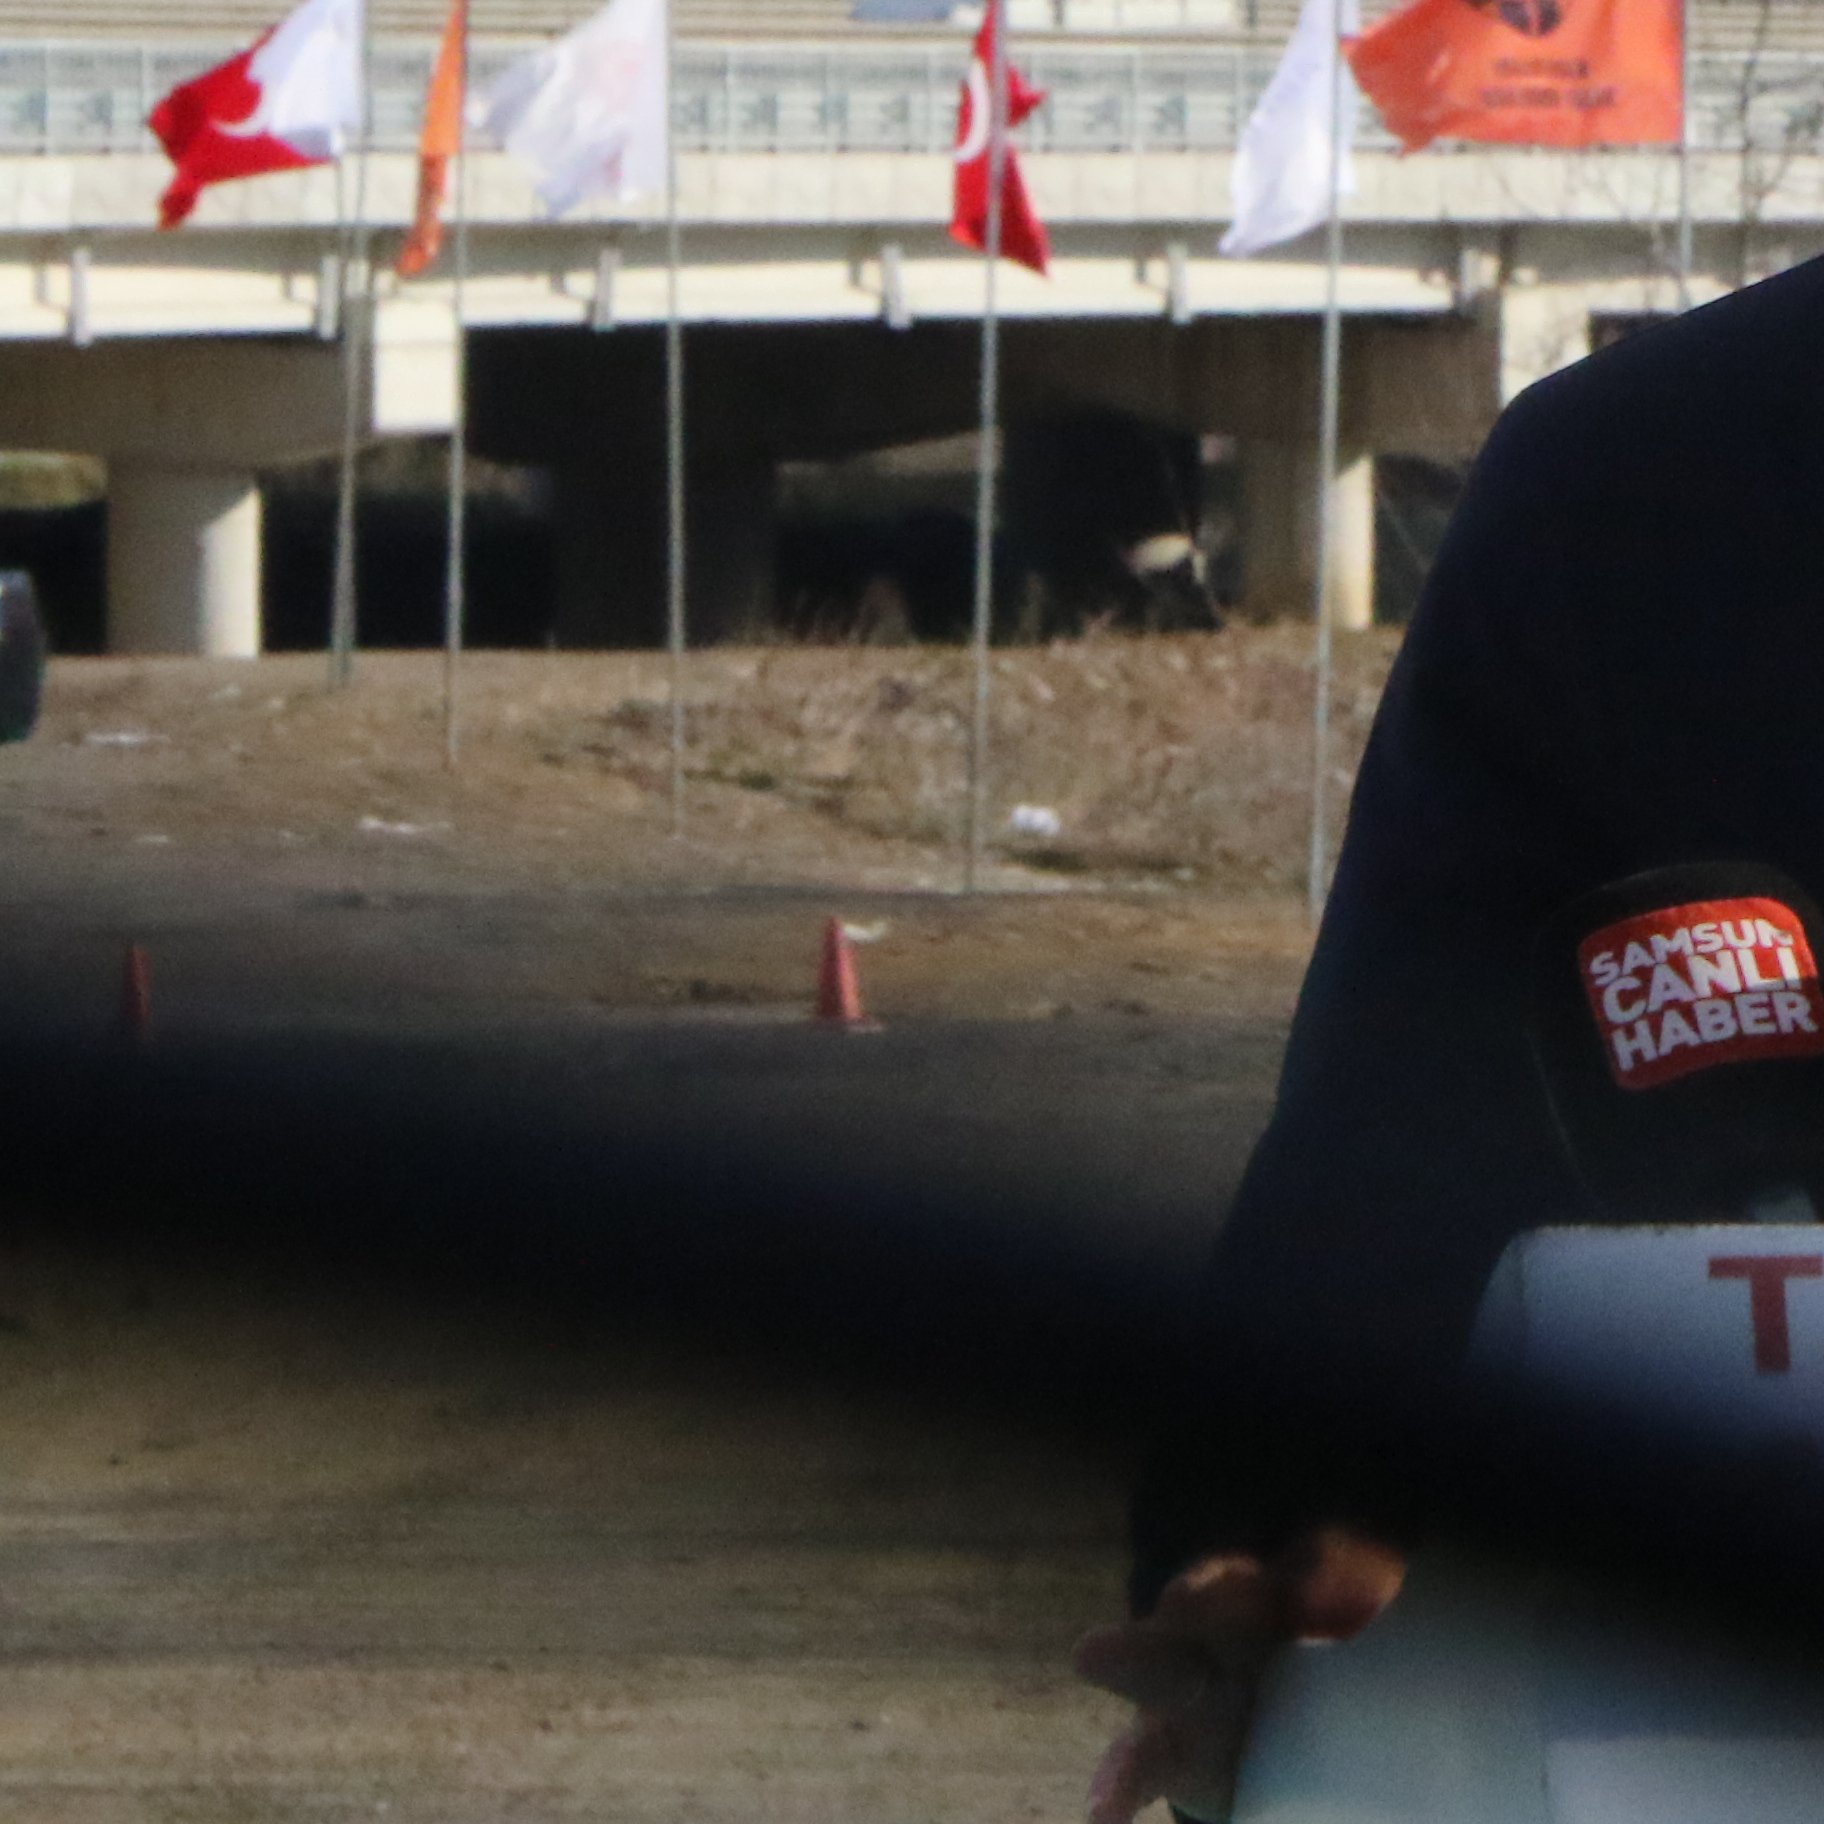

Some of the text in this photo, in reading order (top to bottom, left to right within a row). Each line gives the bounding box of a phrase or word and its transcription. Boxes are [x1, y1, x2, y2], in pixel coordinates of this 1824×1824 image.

[1589, 918, 1795, 988] SAMSUN
[1602, 945, 1801, 1025] CANLI
[1611, 991, 1819, 1072] HABER
